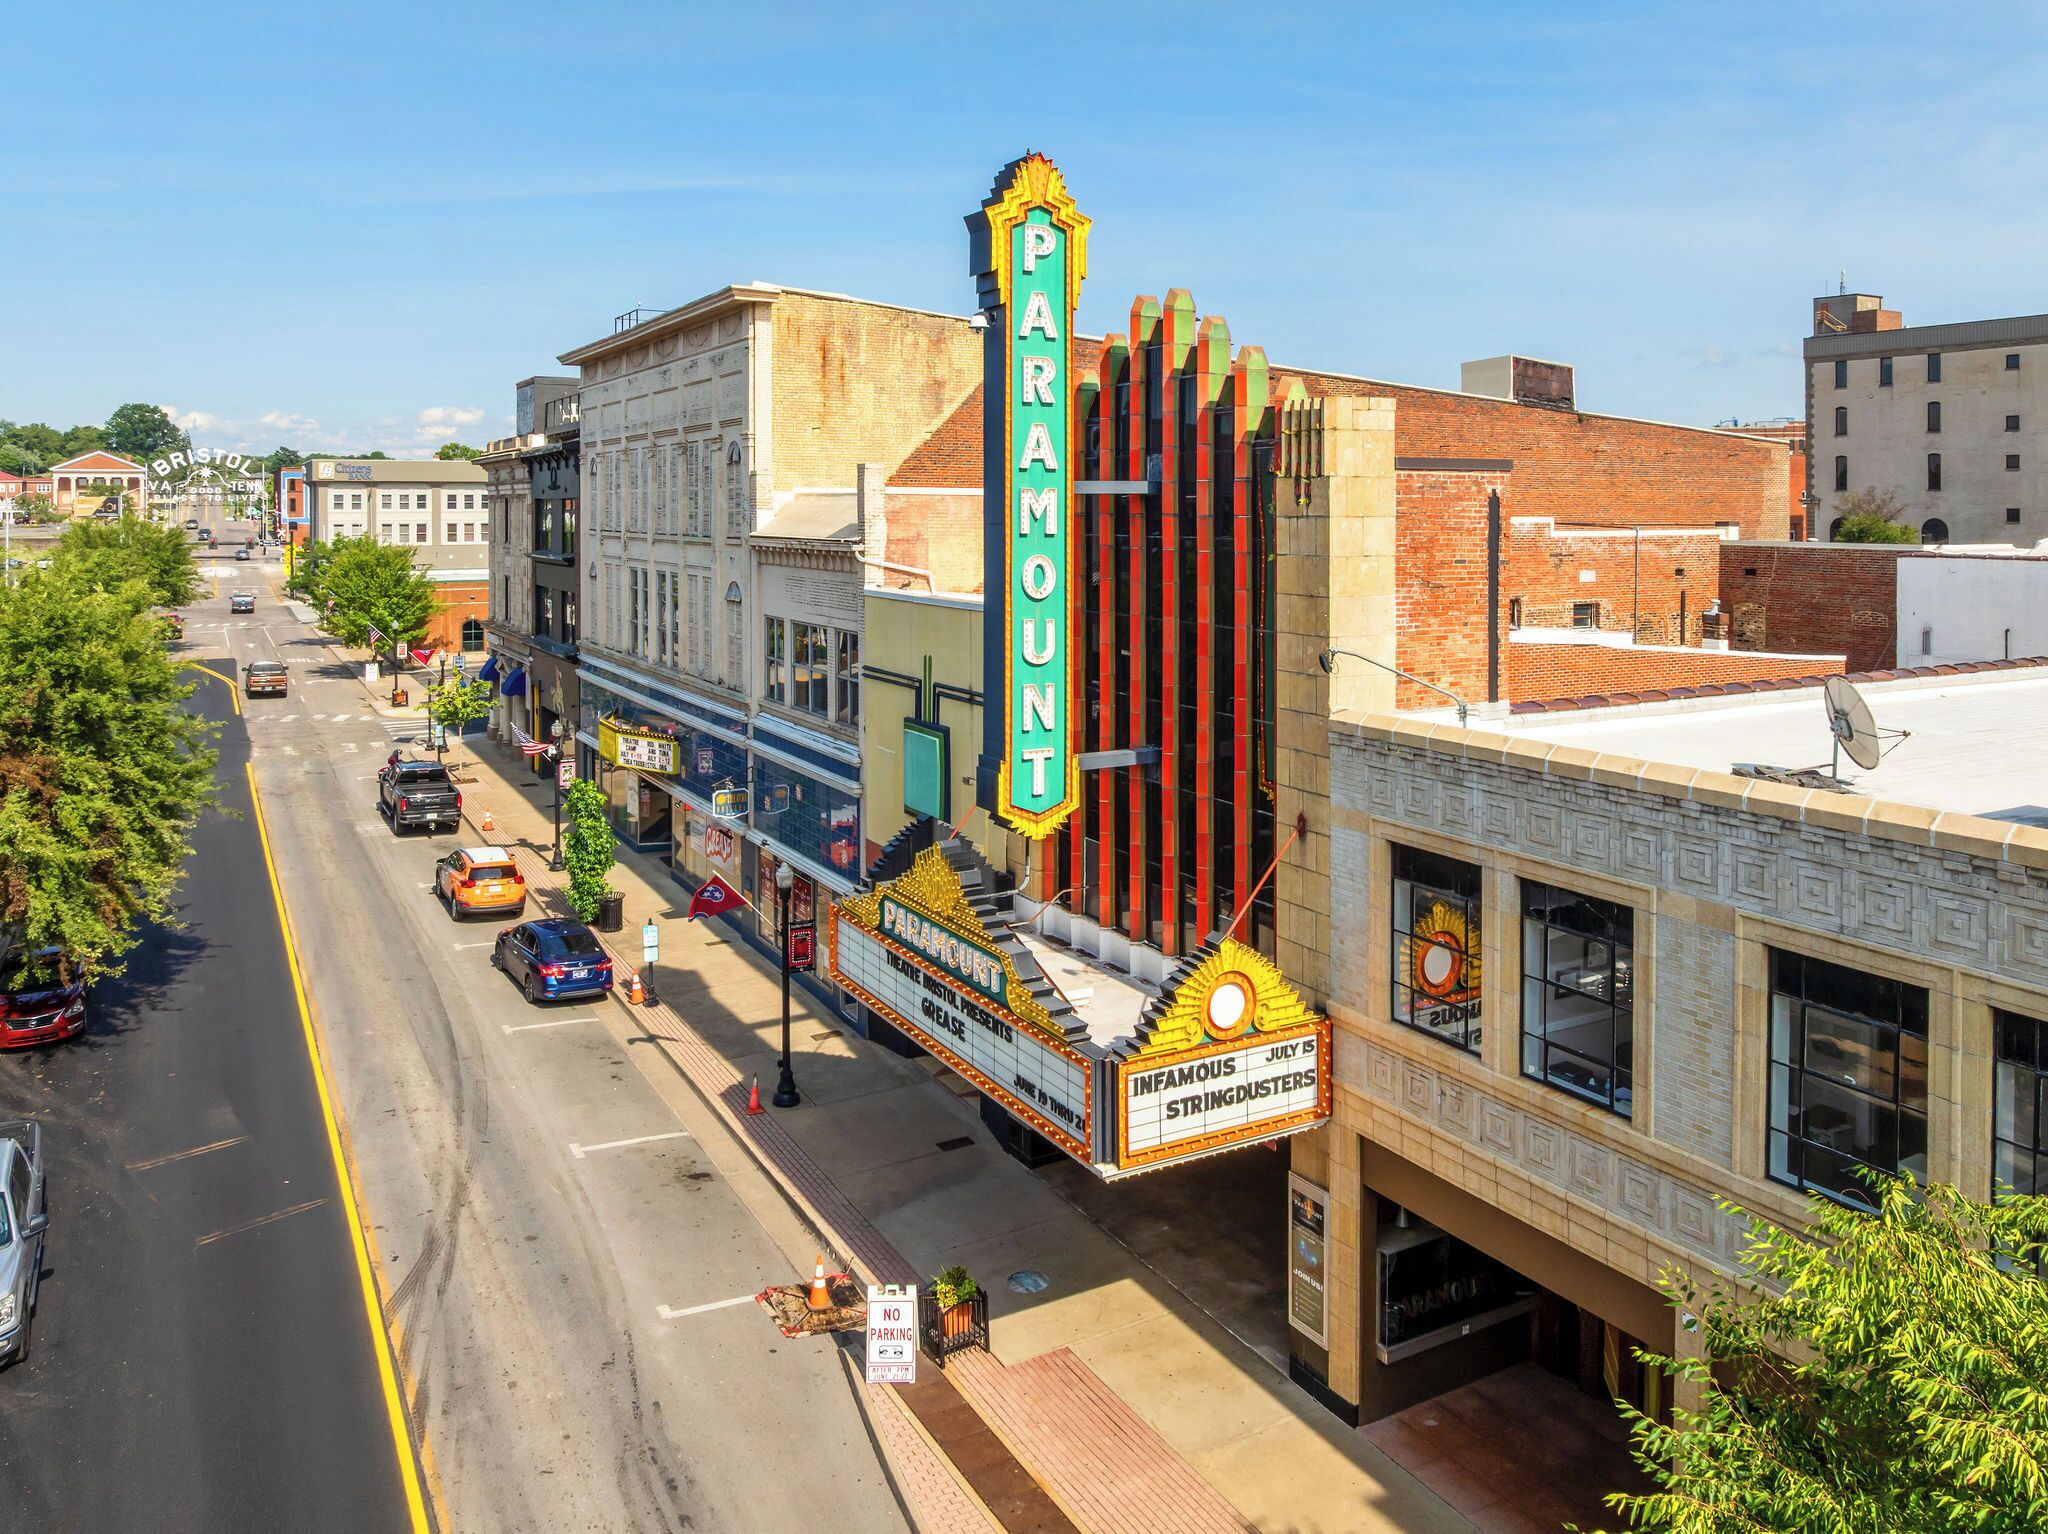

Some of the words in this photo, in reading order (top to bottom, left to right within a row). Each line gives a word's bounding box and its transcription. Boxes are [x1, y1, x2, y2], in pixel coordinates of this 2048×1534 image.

[152, 448, 251, 477] BRISTOL
[336, 463, 372, 474] Citizens
[148, 480, 171, 491] VA
[349, 473, 372, 481] BANK
[154, 494, 197, 502] PLACE
[208, 494, 222, 502] TO
[228, 494, 259, 502] LIVE
[1019, 223, 1058, 797] PARAMOUNT
[622, 737, 639, 745] THEATRE
[883, 899, 1003, 994] PARAMOUNT
[886, 949, 921, 985] THEATRE
[922, 968, 960, 1011] BRISTOL
[961, 999, 1013, 1044] PRESENTS
[922, 997, 966, 1042] GREASE
[1265, 1041, 1300, 1062] JULY
[1302, 1039, 1315, 1055] 15
[1133, 1057, 1236, 1097] INFAMOUS
[1013, 1073, 1036, 1098] JUNE
[1049, 1095, 1074, 1124] THRU
[1166, 1068, 1316, 1120] STRINGDUSTERS
[1292, 1268, 1311, 1286] JOIN
[1310, 1277, 1324, 1293] US!
[883, 1308, 901, 1321] NO
[870, 1328, 913, 1341] PARKING
